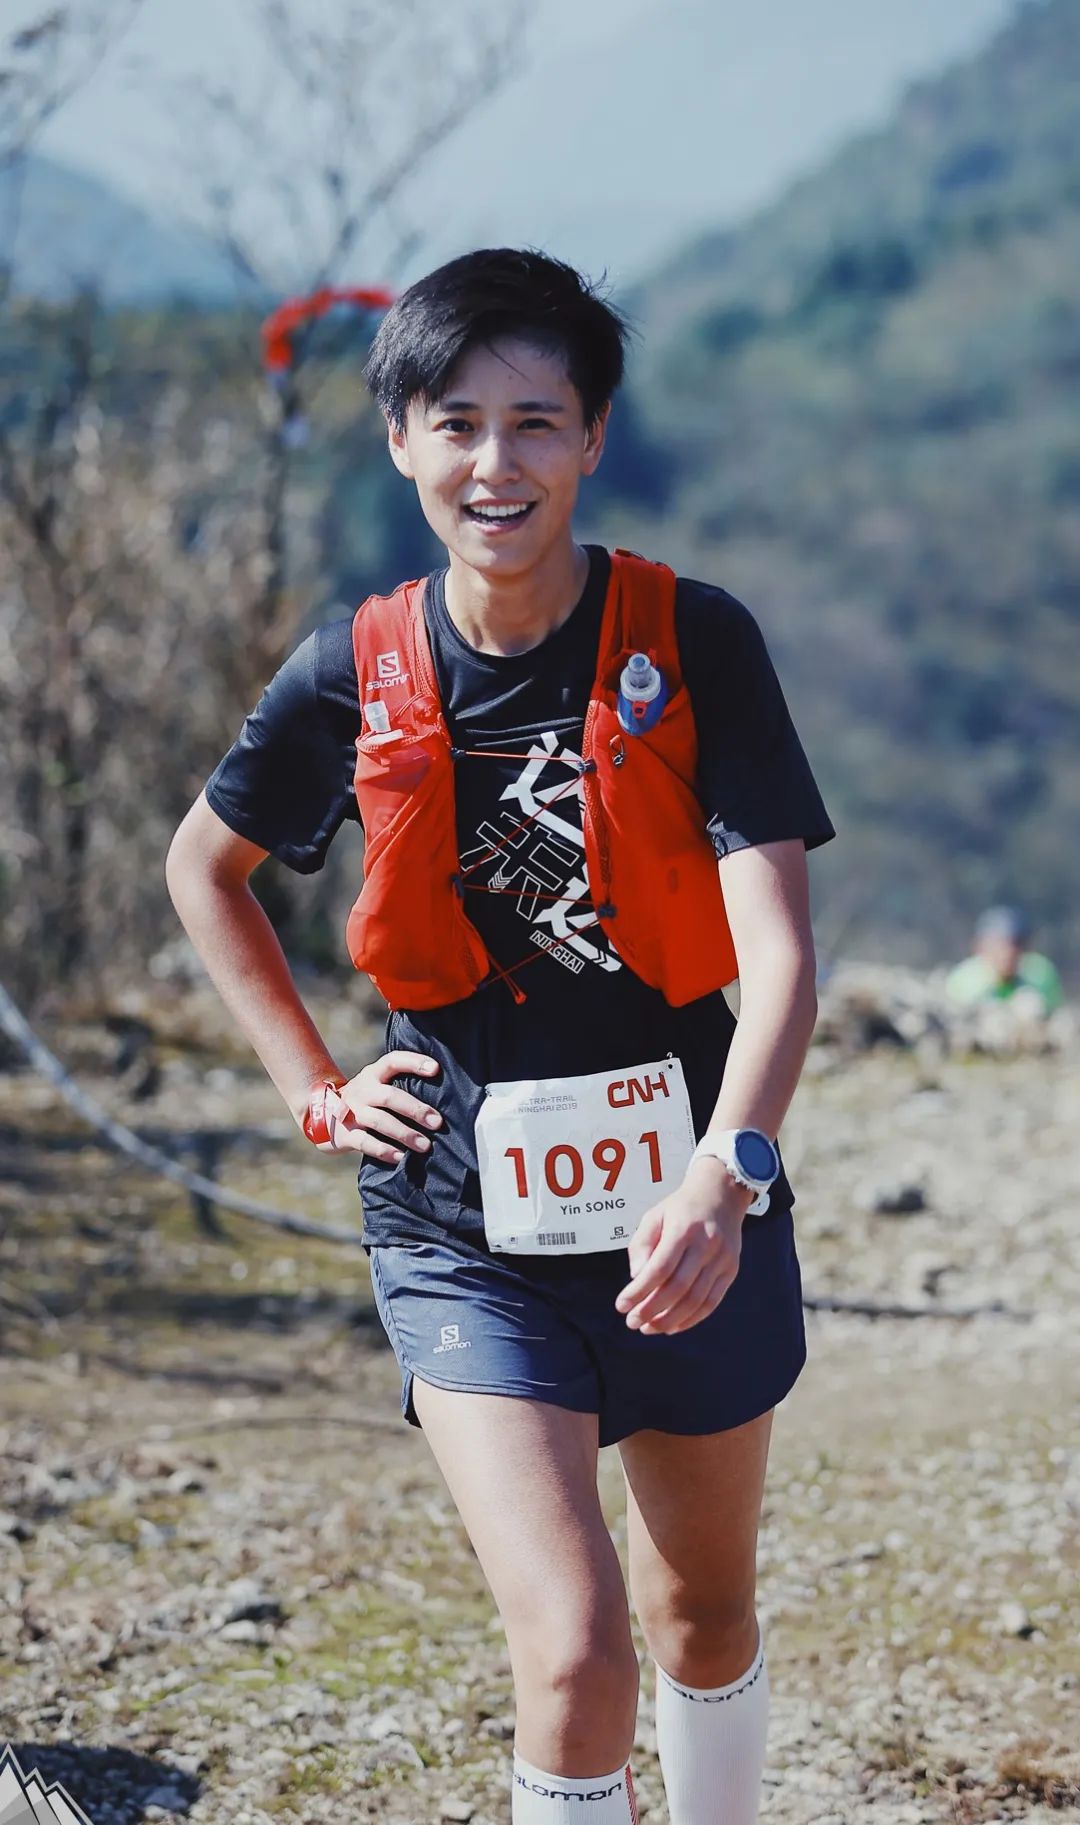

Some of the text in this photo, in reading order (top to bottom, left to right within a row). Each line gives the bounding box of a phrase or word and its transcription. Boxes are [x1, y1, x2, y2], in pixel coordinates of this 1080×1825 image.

[531, 932, 582, 972] NINGHAI
[519, 1095, 577, 1106] TRA-TRAIL
[607, 1071, 670, 1108] CNH
[504, 1131, 662, 1198] 1091
[560, 1198, 626, 1215] Yin SONG
[514, 1774, 622, 1802] alomon
